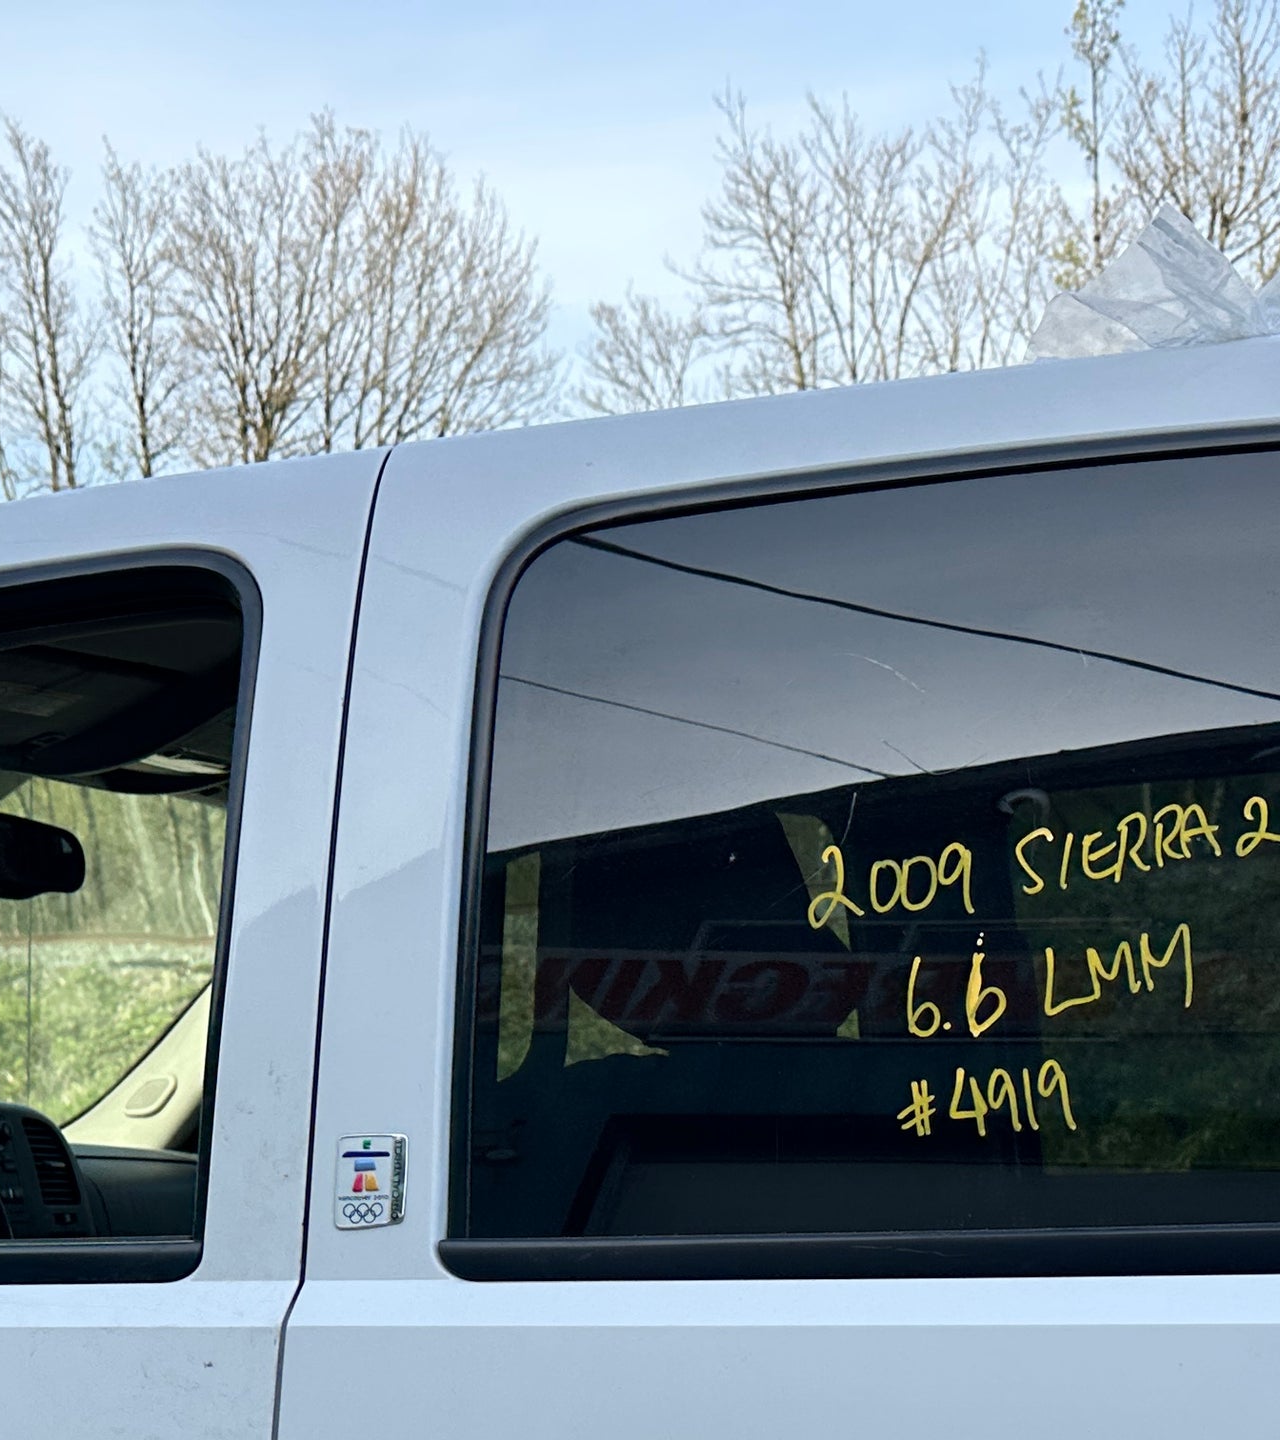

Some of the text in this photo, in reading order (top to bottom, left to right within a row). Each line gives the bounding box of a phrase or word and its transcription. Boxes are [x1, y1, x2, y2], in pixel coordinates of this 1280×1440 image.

[808, 840, 975, 930] 2009
[1016, 802, 1222, 894] SIERRA
[907, 952, 1007, 1038] 6.6
[1043, 922, 1194, 1008] LMM
[896, 1058, 1077, 1137] #4919
